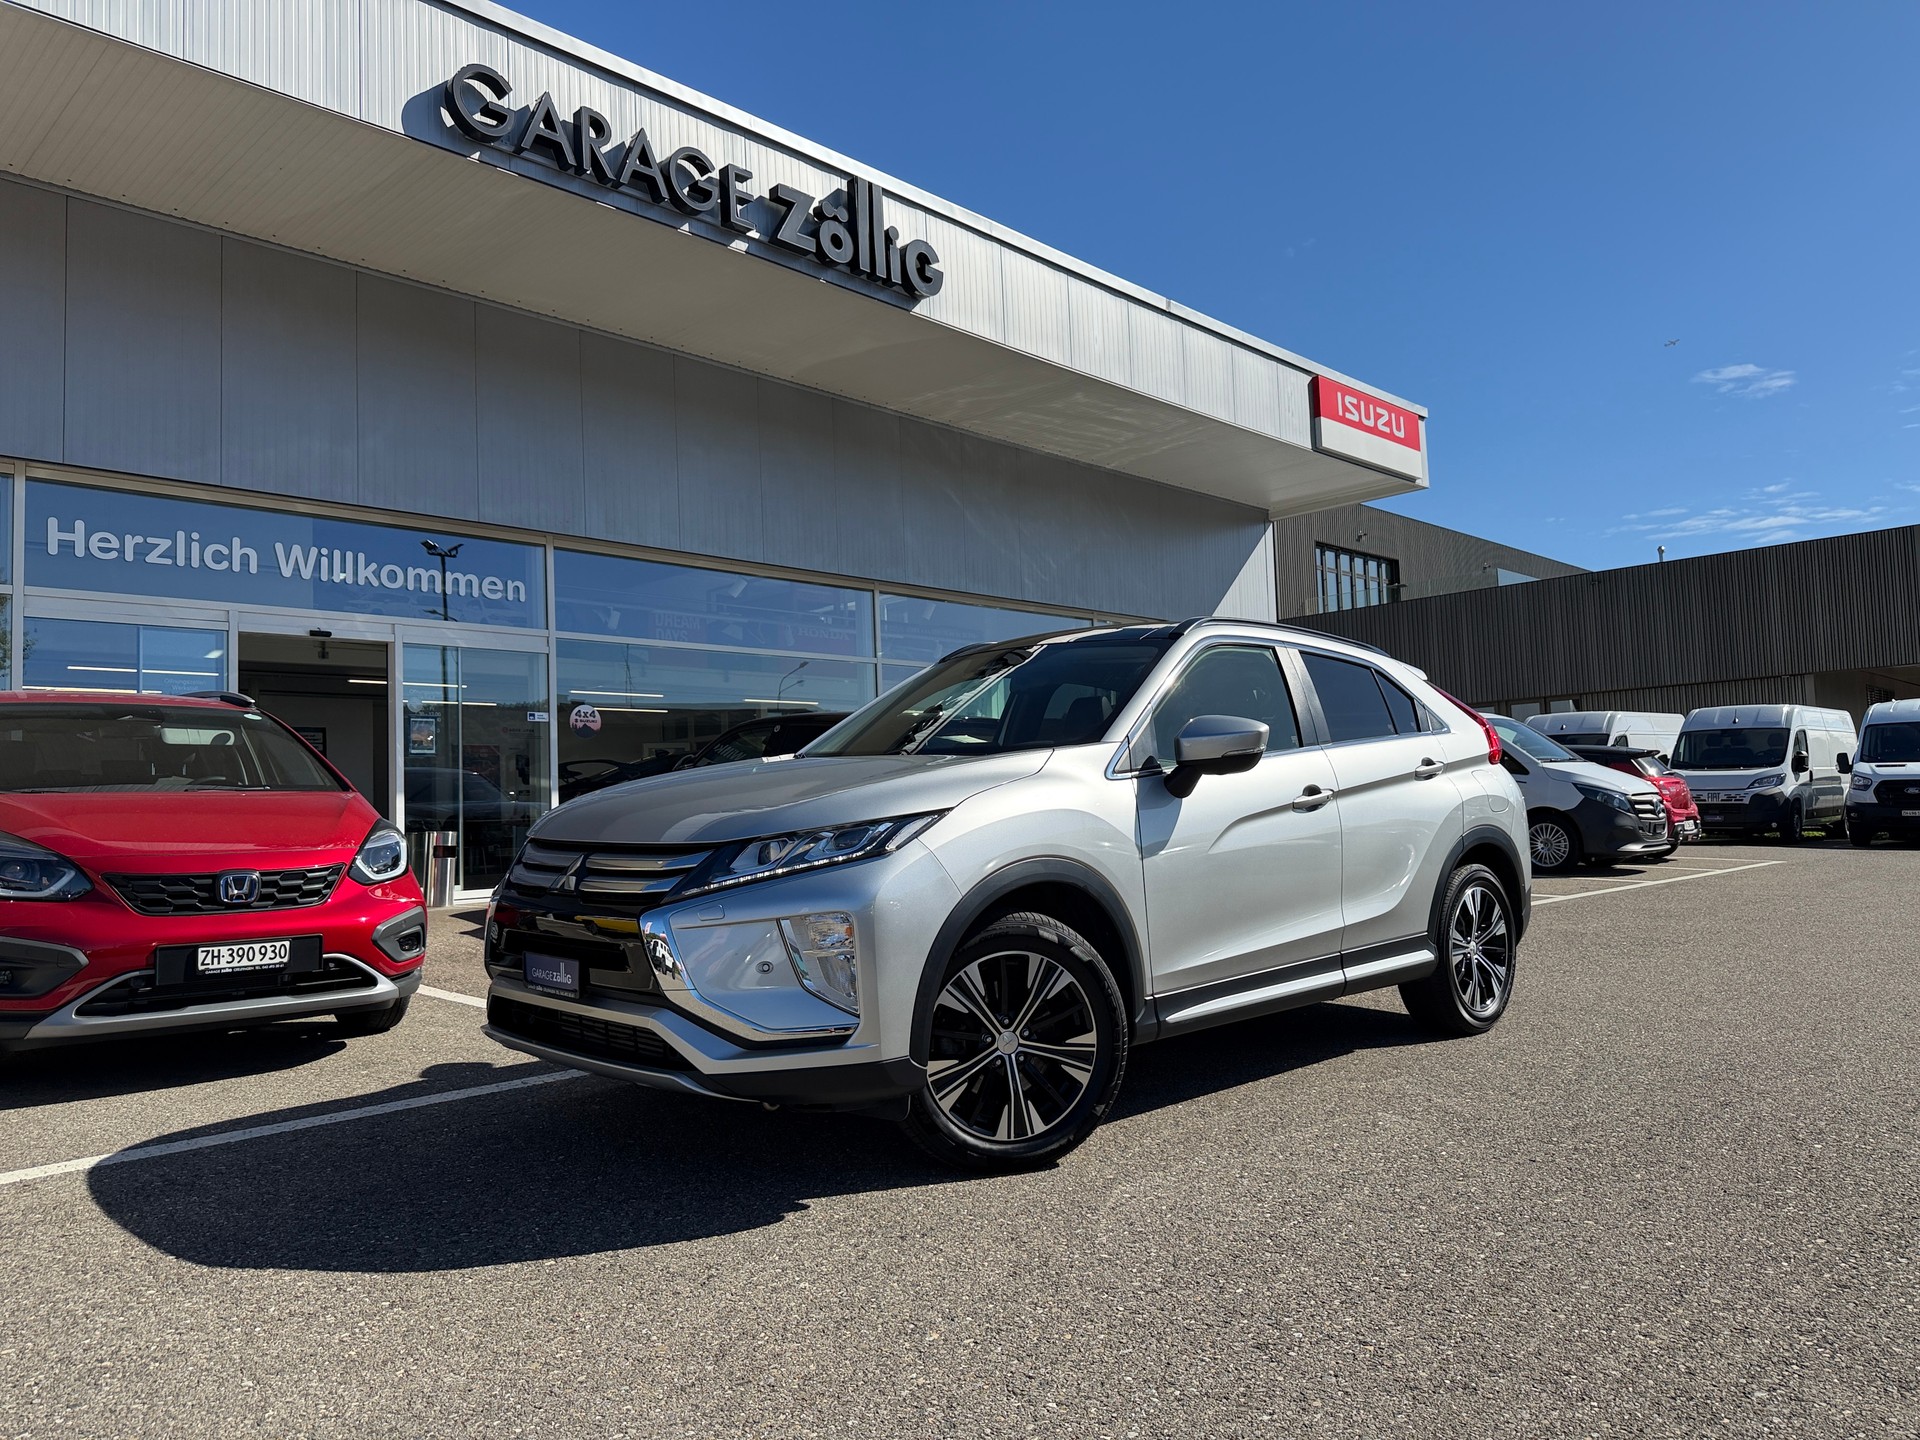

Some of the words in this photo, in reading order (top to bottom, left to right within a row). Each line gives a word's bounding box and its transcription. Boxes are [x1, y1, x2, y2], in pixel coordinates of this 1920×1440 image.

[445, 62, 755, 234] GARAGE
[1337, 391, 1405, 438] ISUZU
[47, 516, 258, 574] Herzlich
[274, 542, 526, 603] Willkommen
[655, 613, 700, 630] DREAM
[574, 709, 597, 718] 4x4
[1707, 792, 1721, 802] FIAT
[259, 943, 288, 961] 930
[531, 967, 553, 981] GARAGE
